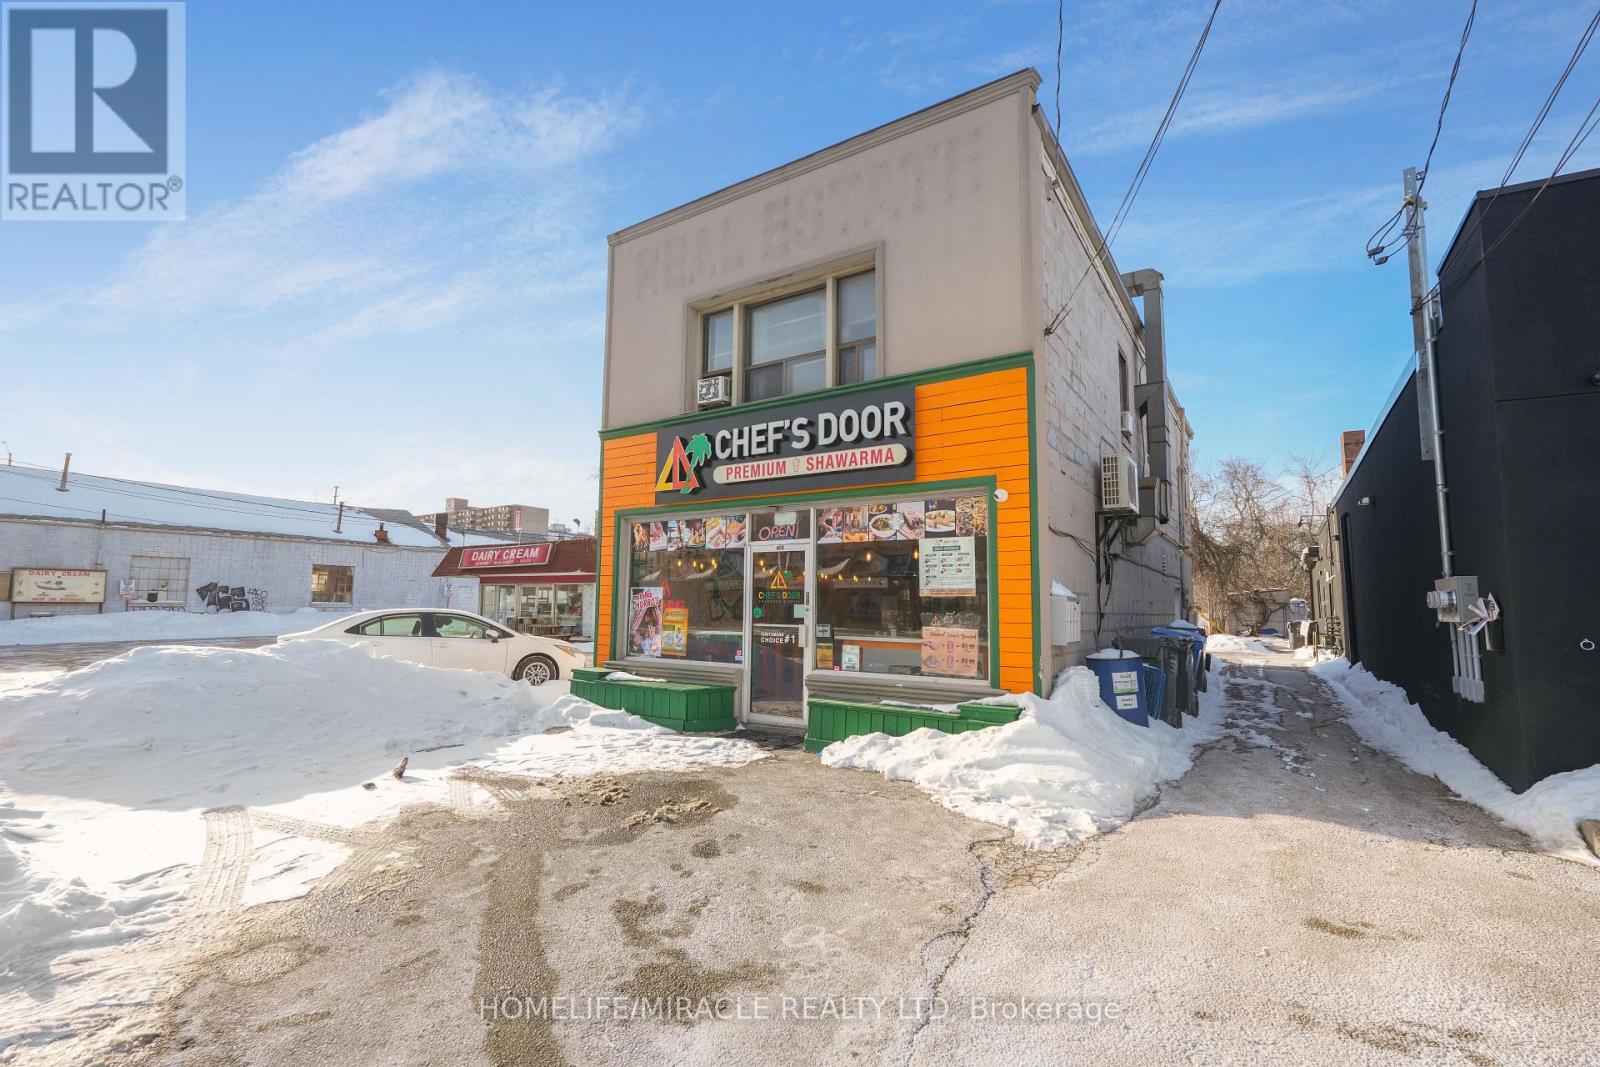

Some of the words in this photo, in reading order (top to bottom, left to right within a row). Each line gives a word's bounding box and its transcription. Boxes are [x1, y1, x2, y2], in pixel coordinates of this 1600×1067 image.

[715, 417, 811, 460] CHEF'S
[818, 401, 907, 446] DOOR
[726, 460, 787, 481] PREMIUM
[806, 447, 895, 472] SHAWARMA
[758, 524, 796, 541] OPEN
[471, 550, 501, 560] DAIRY
[503, 548, 539, 559] CREAM
[760, 636, 784, 644] CHOICE
[784, 633, 796, 644] #1
